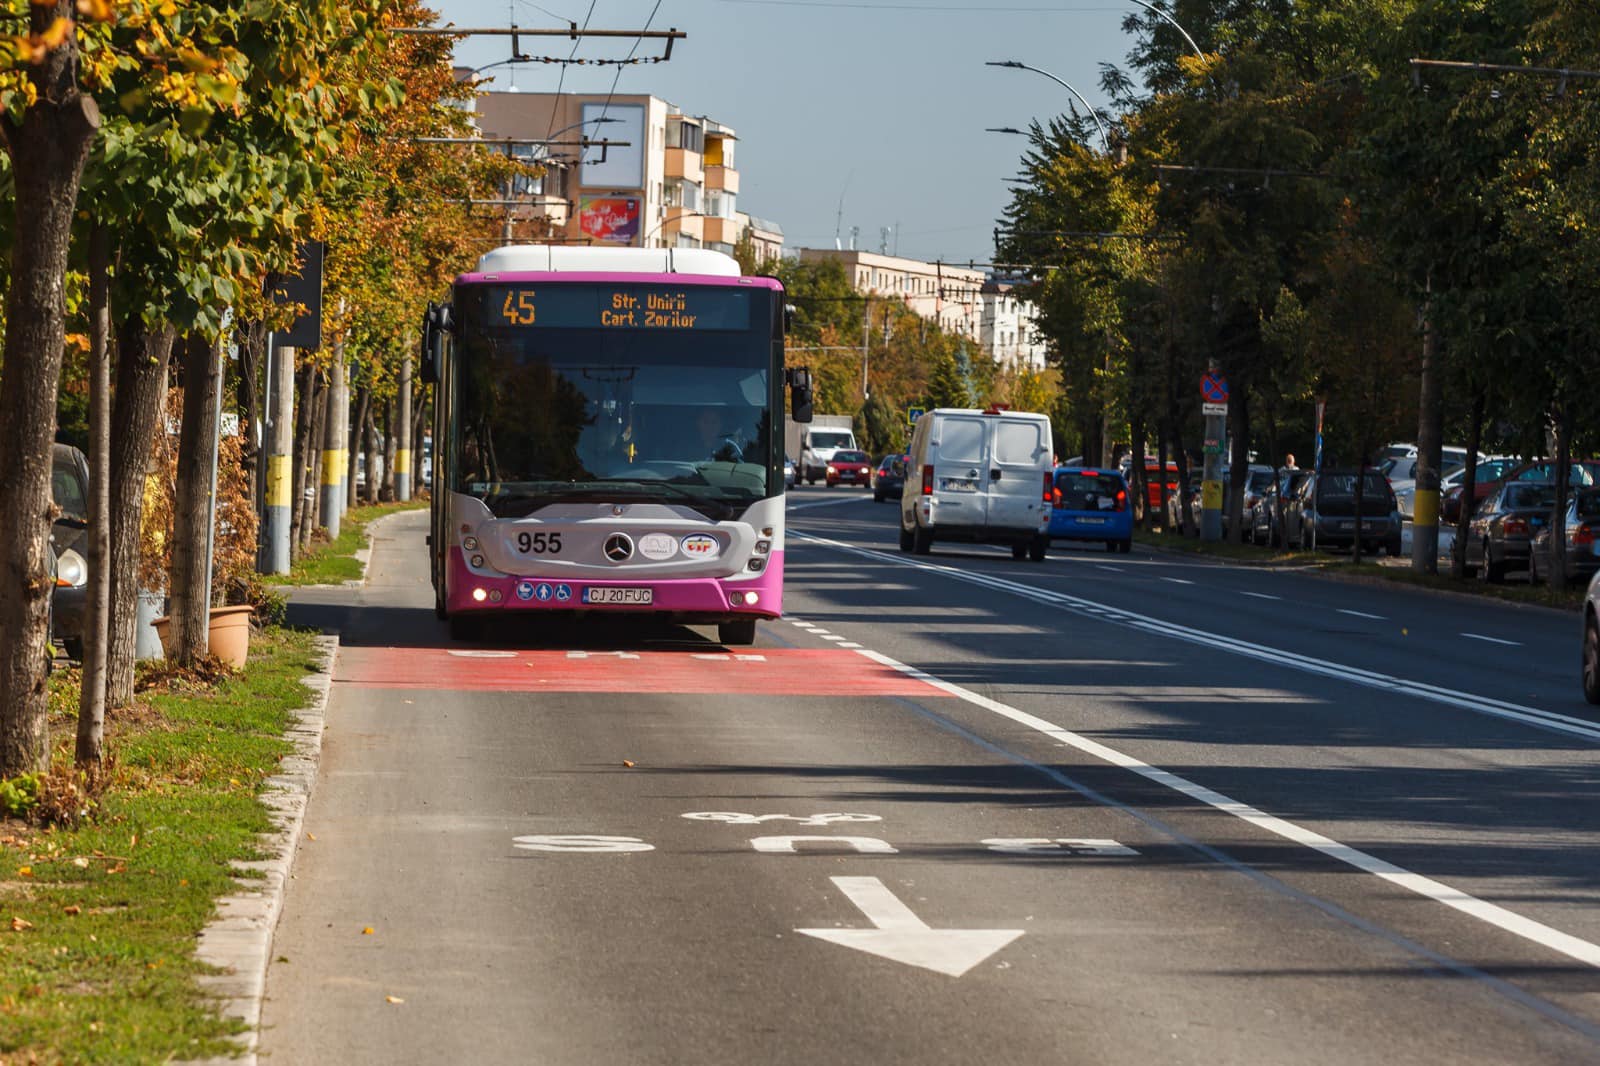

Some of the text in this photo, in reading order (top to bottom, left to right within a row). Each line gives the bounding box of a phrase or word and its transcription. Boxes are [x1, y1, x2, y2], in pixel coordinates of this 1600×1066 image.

[502, 290, 536, 325] 45
[612, 293, 685, 311] Str. Unirii
[601, 310, 697, 328] Cart. Zorilor
[517, 532, 562, 554] 955
[590, 589, 605, 601] CJ
[609, 590, 623, 601] 20
